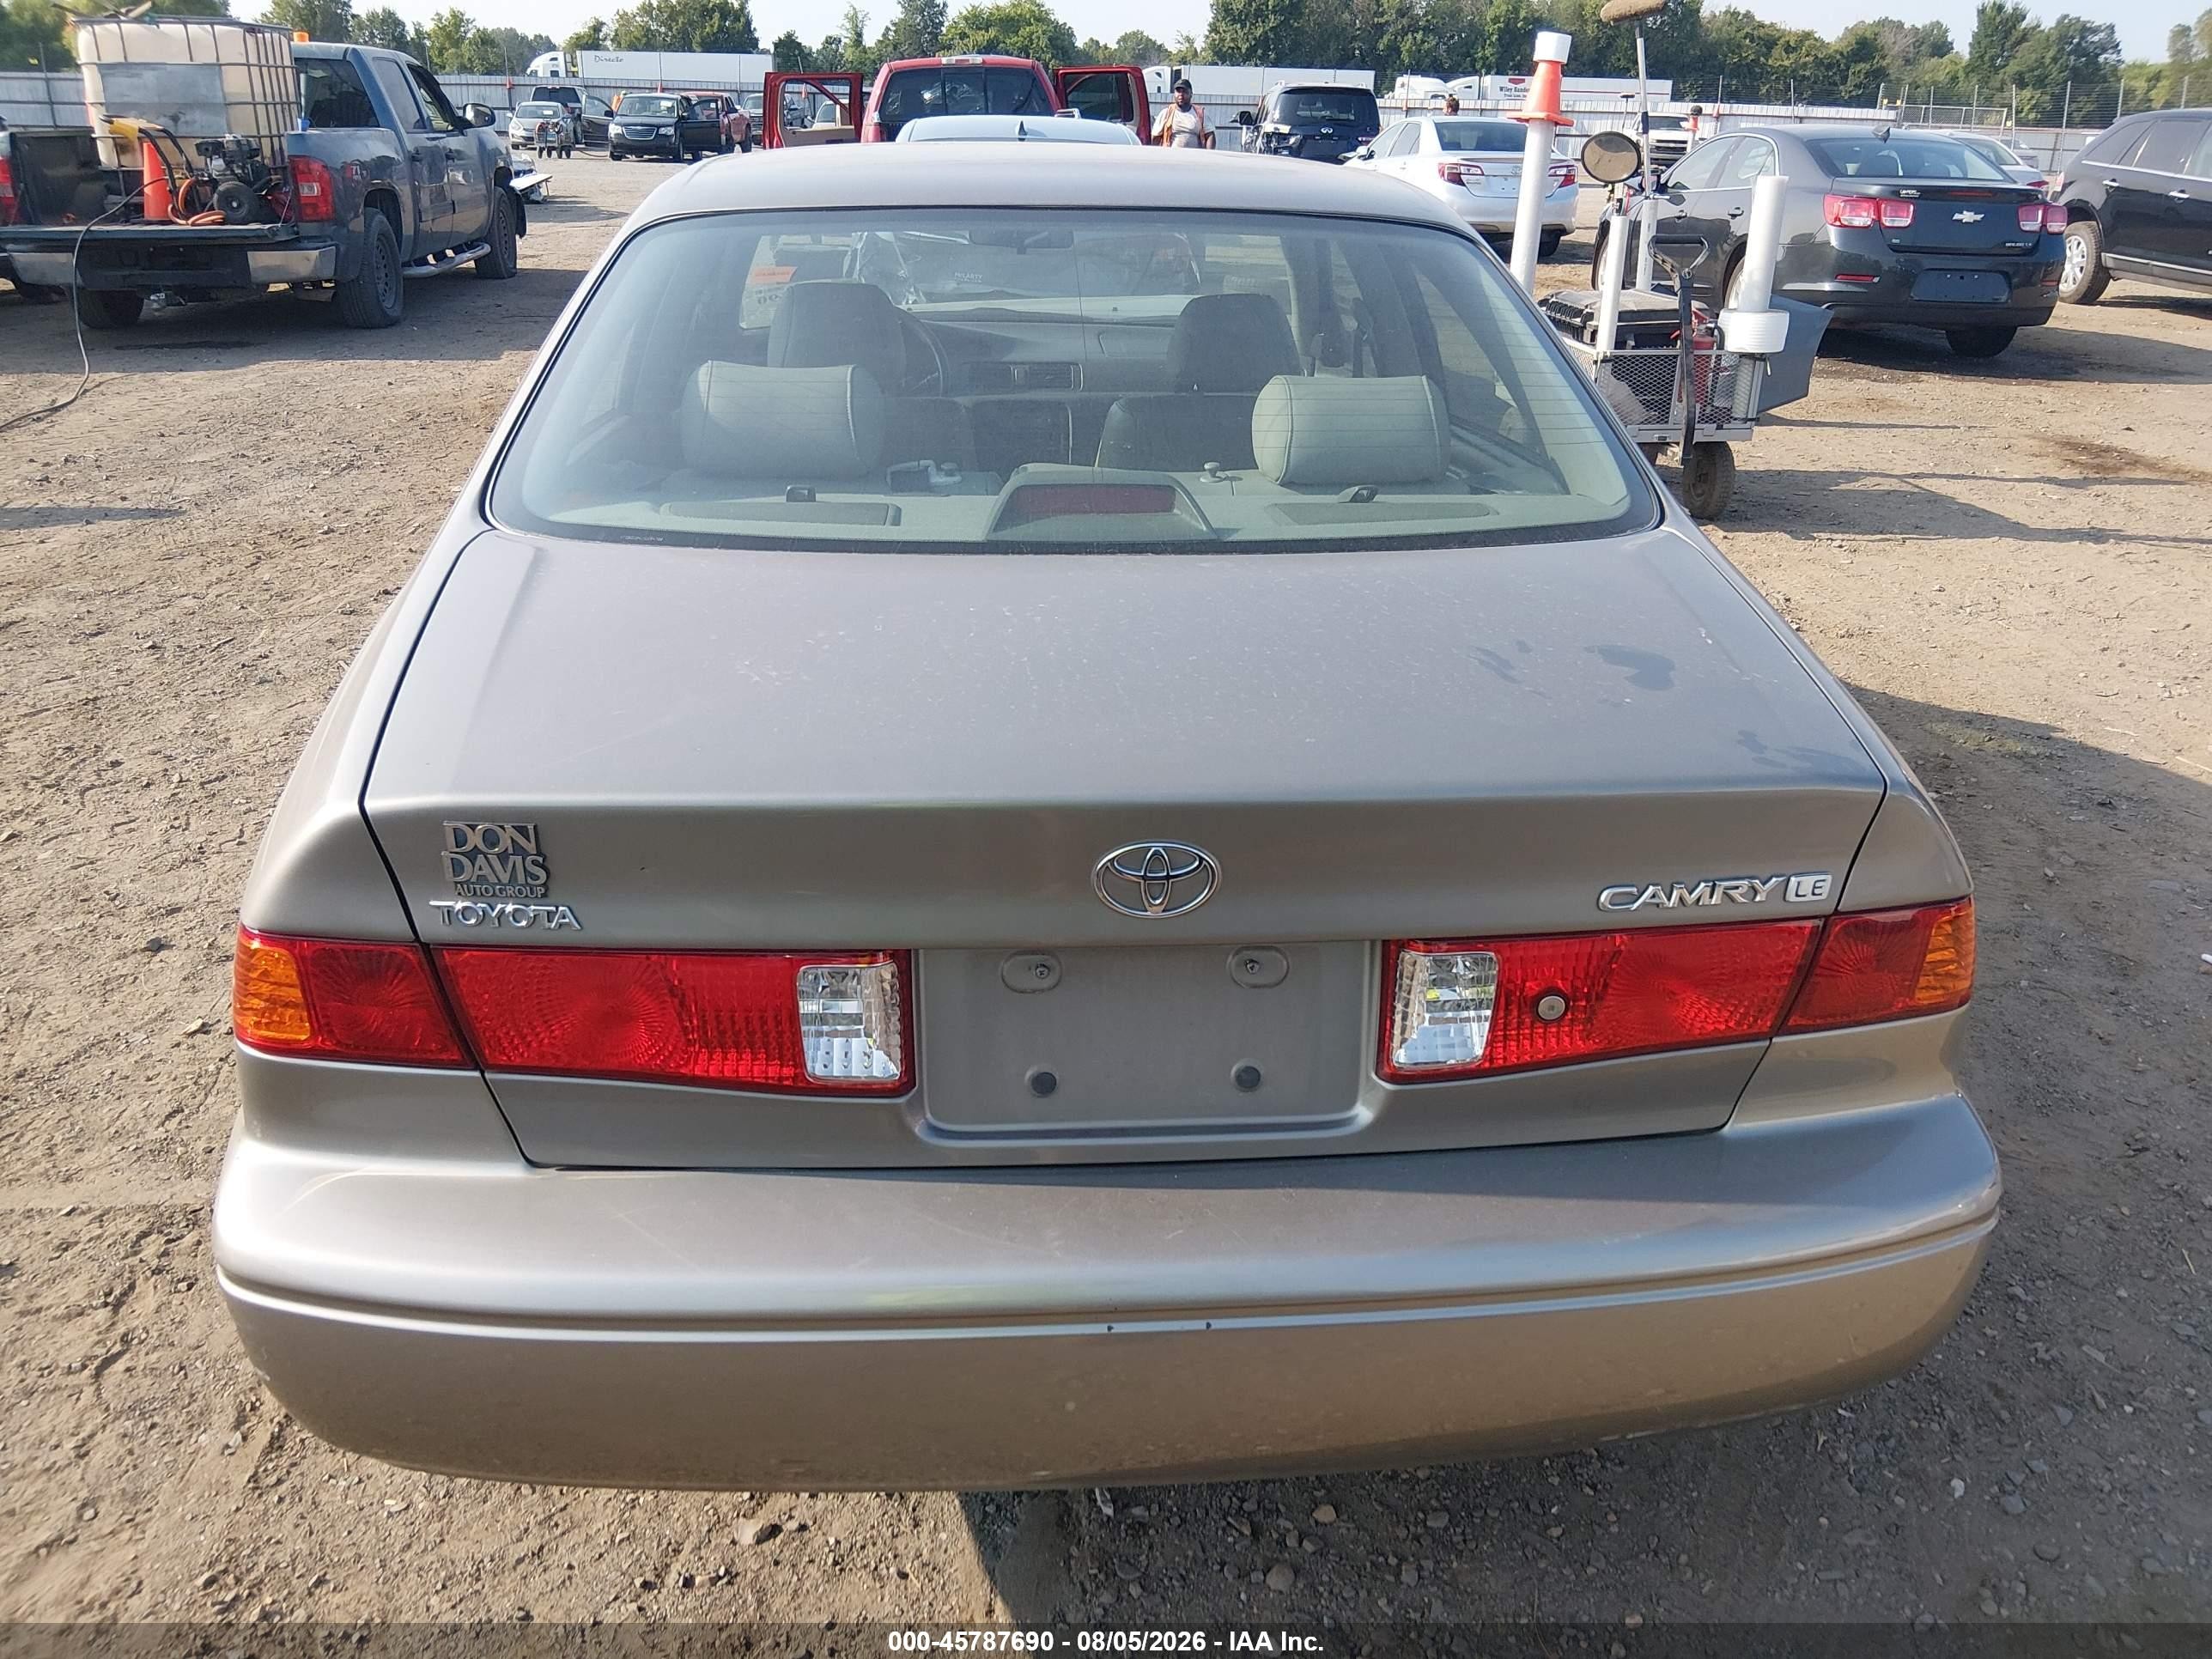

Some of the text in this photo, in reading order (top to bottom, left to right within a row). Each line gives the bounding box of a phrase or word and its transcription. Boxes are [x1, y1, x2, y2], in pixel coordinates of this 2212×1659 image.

[442, 821, 537, 854] DON
[441, 851, 548, 886] DAVIS
[454, 884, 546, 898] AUTO GROUP
[1598, 876, 1826, 911] CAMRY LE
[429, 900, 582, 930] TOYOTA
